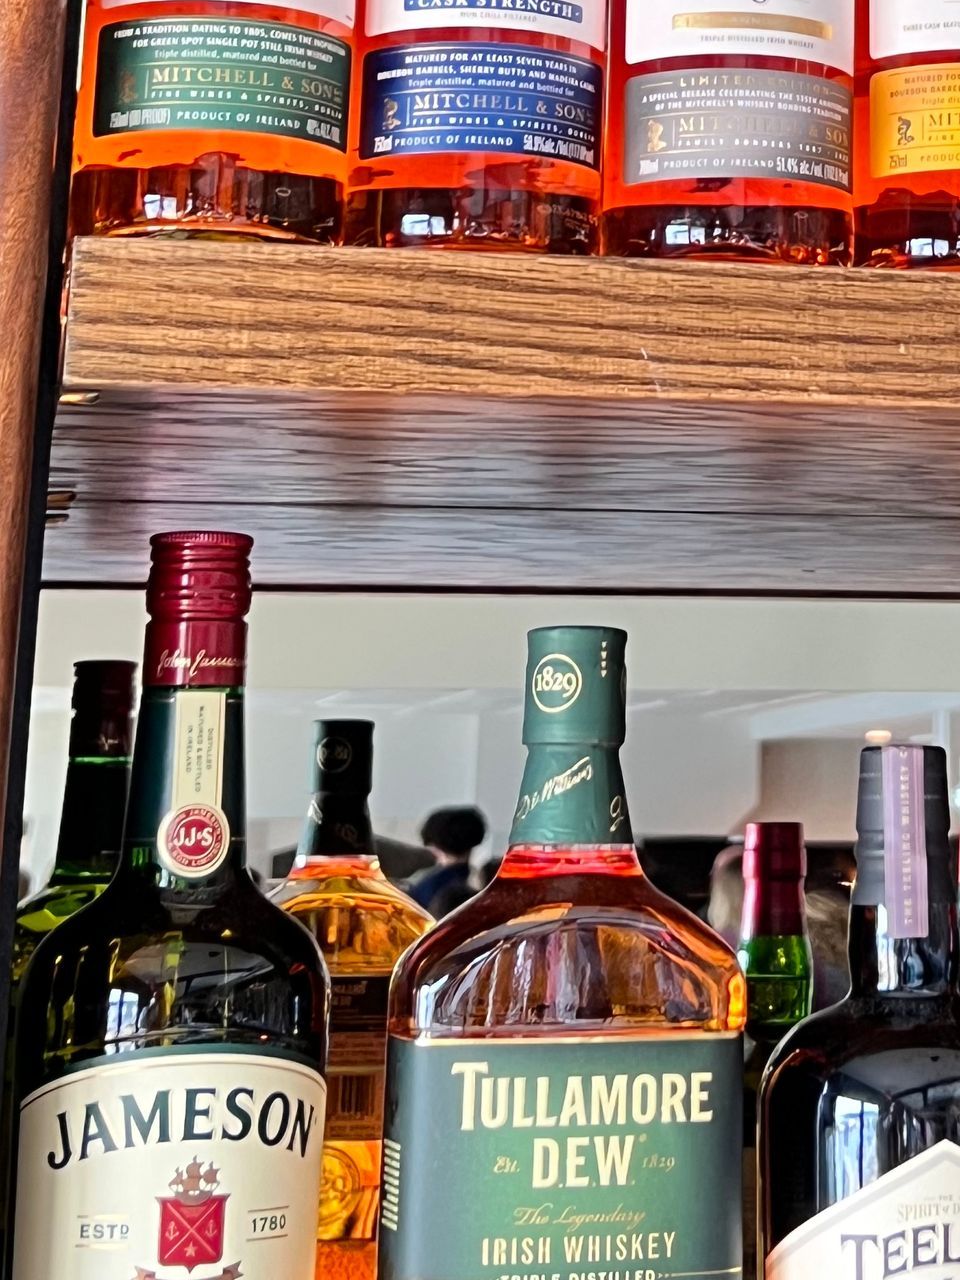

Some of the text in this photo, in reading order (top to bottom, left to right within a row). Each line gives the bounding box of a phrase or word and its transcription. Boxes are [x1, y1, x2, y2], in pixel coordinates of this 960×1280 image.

[142, 25, 226, 34] TRADITION DATING
[151, 37, 282, 51] GREEN SPOT SINGLE POT STILL
[487, 54, 512, 62] LEAST
[516, 56, 542, 66] SEVEN
[152, 67, 294, 91] MITCHELL &
[460, 66, 546, 79] SHERRY BUTTS AND
[478, 79, 515, 87] matured
[680, 76, 754, 87] LIMITED
[904, 75, 943, 84] MATURED
[682, 89, 792, 100] RELEASE CELEBRATING THE
[890, 87, 927, 98] BOURBON
[414, 94, 548, 115] MITCHELL &
[738, 100, 774, 108] WHISKEY
[778, 102, 811, 113] BONDING
[177, 111, 300, 129] PRODUCT OF IRELAND
[395, 135, 513, 146] PRODUCT OF IRELAND
[735, 139, 790, 149] BONDERS
[664, 159, 707, 168] PRODUCT
[731, 159, 774, 167] IRELAND
[536, 666, 576, 698] 1829
[451, 1062, 713, 1130] TULLAMORE
[47, 1087, 314, 1169] JAMESON
[493, 1135, 675, 1188] Est. D.E.W. 1829
[898, 1202, 940, 1220] SPIRIT
[515, 1204, 646, 1232] The Legendary
[80, 1215, 286, 1239] ESTD 1780
[482, 1232, 676, 1265] IRISH WHISKEY
